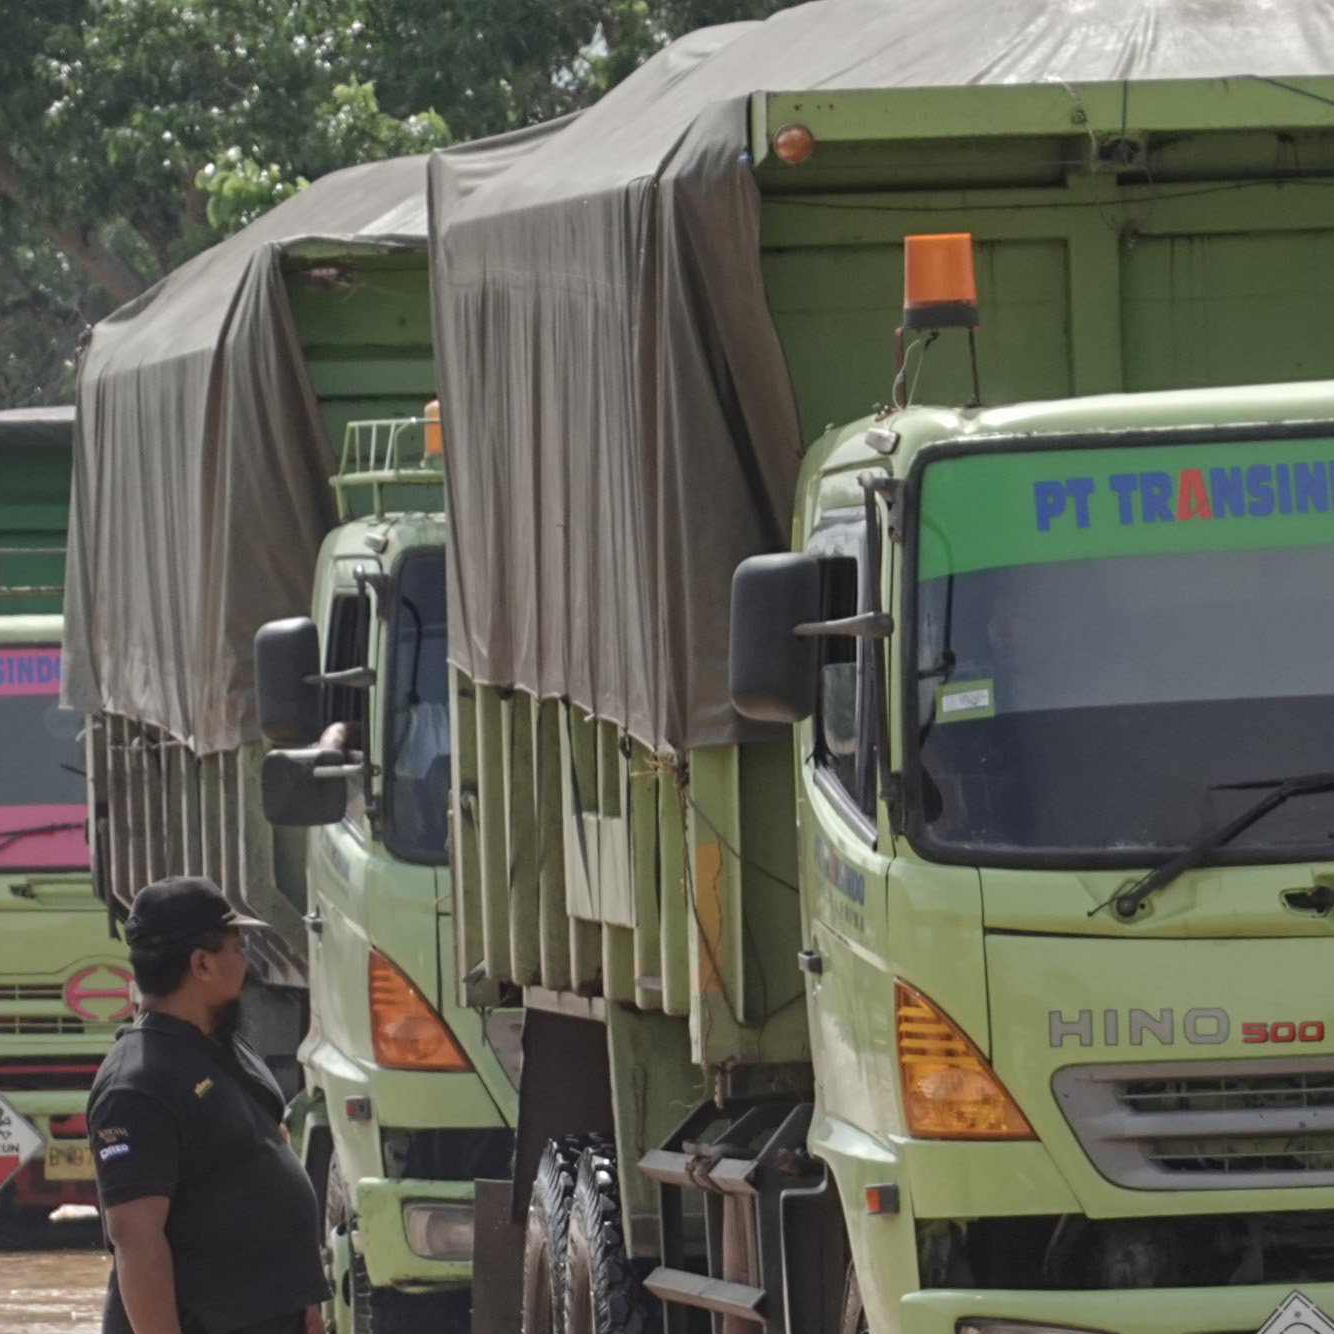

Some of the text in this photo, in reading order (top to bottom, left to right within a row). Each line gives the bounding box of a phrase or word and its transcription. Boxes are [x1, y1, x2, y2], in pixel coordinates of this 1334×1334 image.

[1033, 478, 1094, 532] PT
[1048, 1007, 1325, 1048] HINO 500
[100, 1144, 130, 1161] OREO
